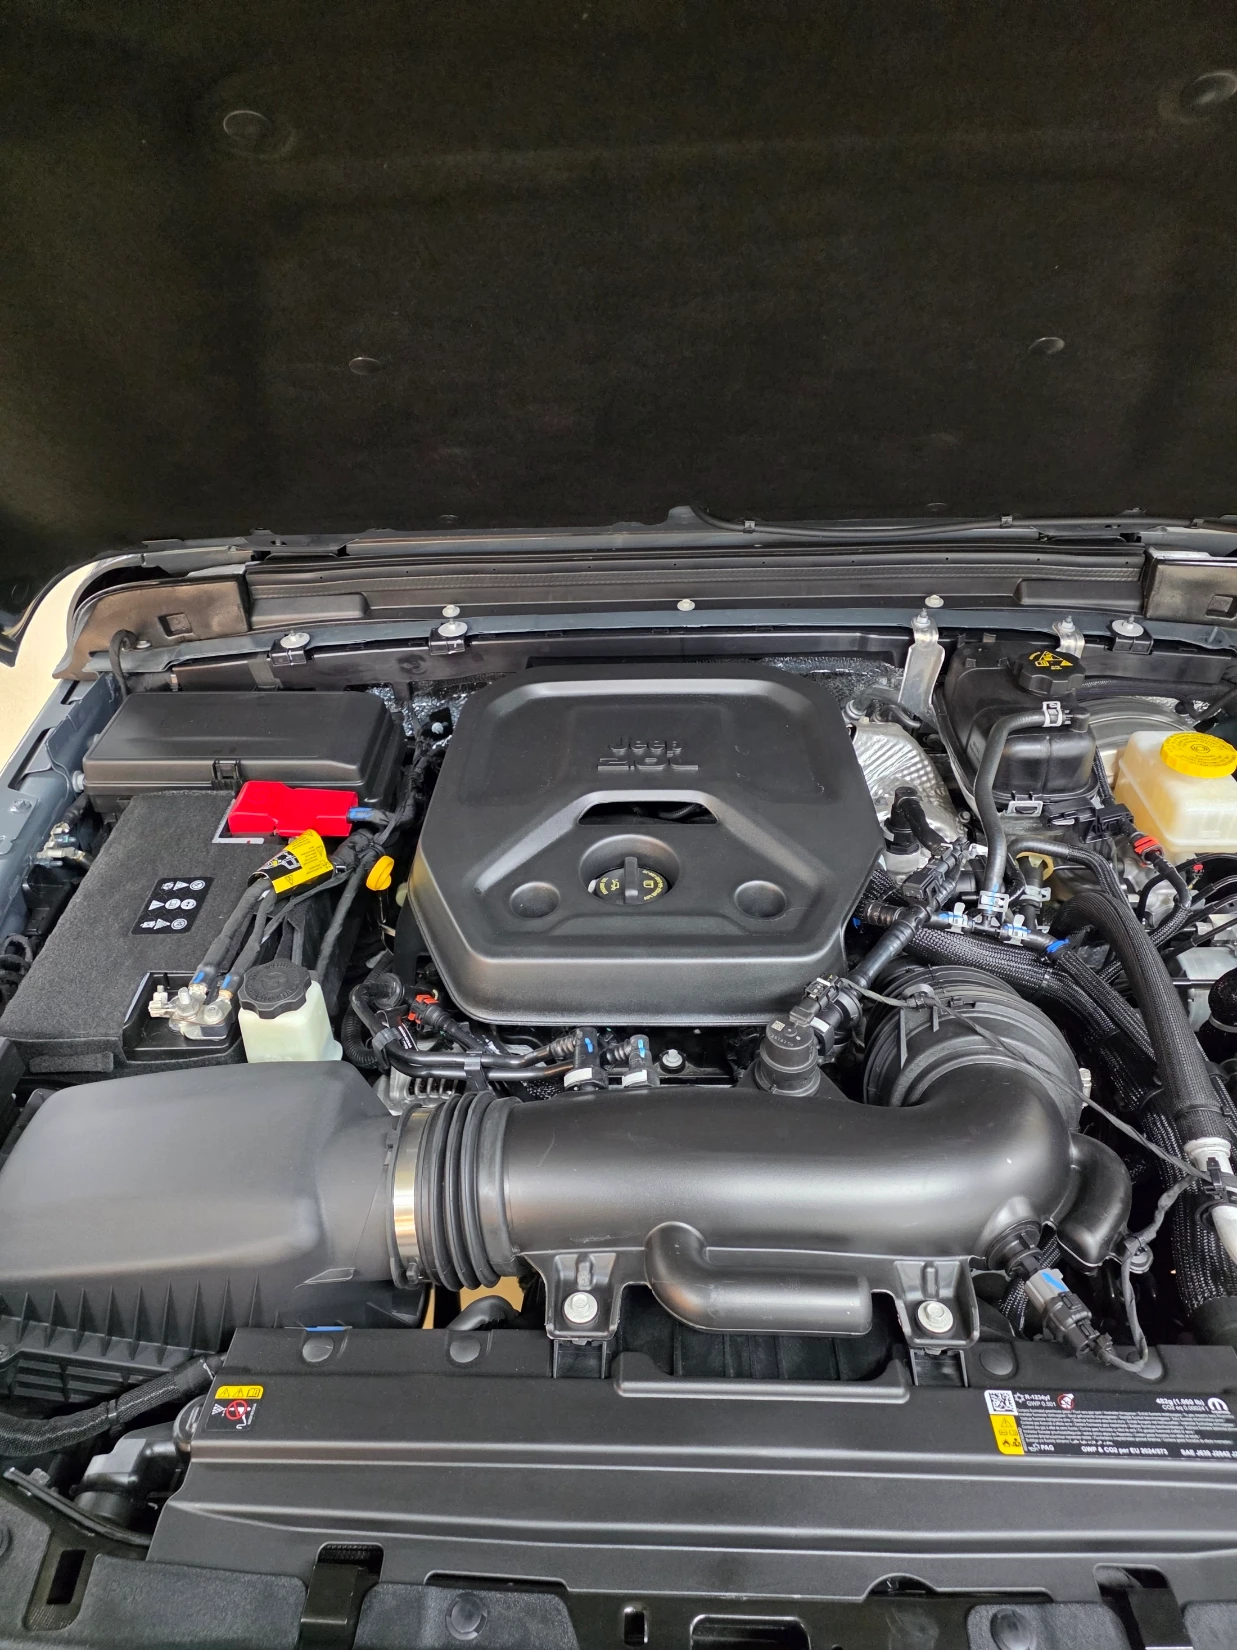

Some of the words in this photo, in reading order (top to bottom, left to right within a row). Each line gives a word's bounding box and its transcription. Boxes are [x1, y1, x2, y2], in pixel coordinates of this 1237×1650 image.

[609, 737, 682, 757] Jeep
[597, 757, 699, 771] 2.0L
[1025, 1394, 1051, 1402] R-1234yf
[1104, 1446, 1118, 1454] CO2
[1118, 1447, 1130, 1455] per
[1129, 1447, 1140, 1455] EU
